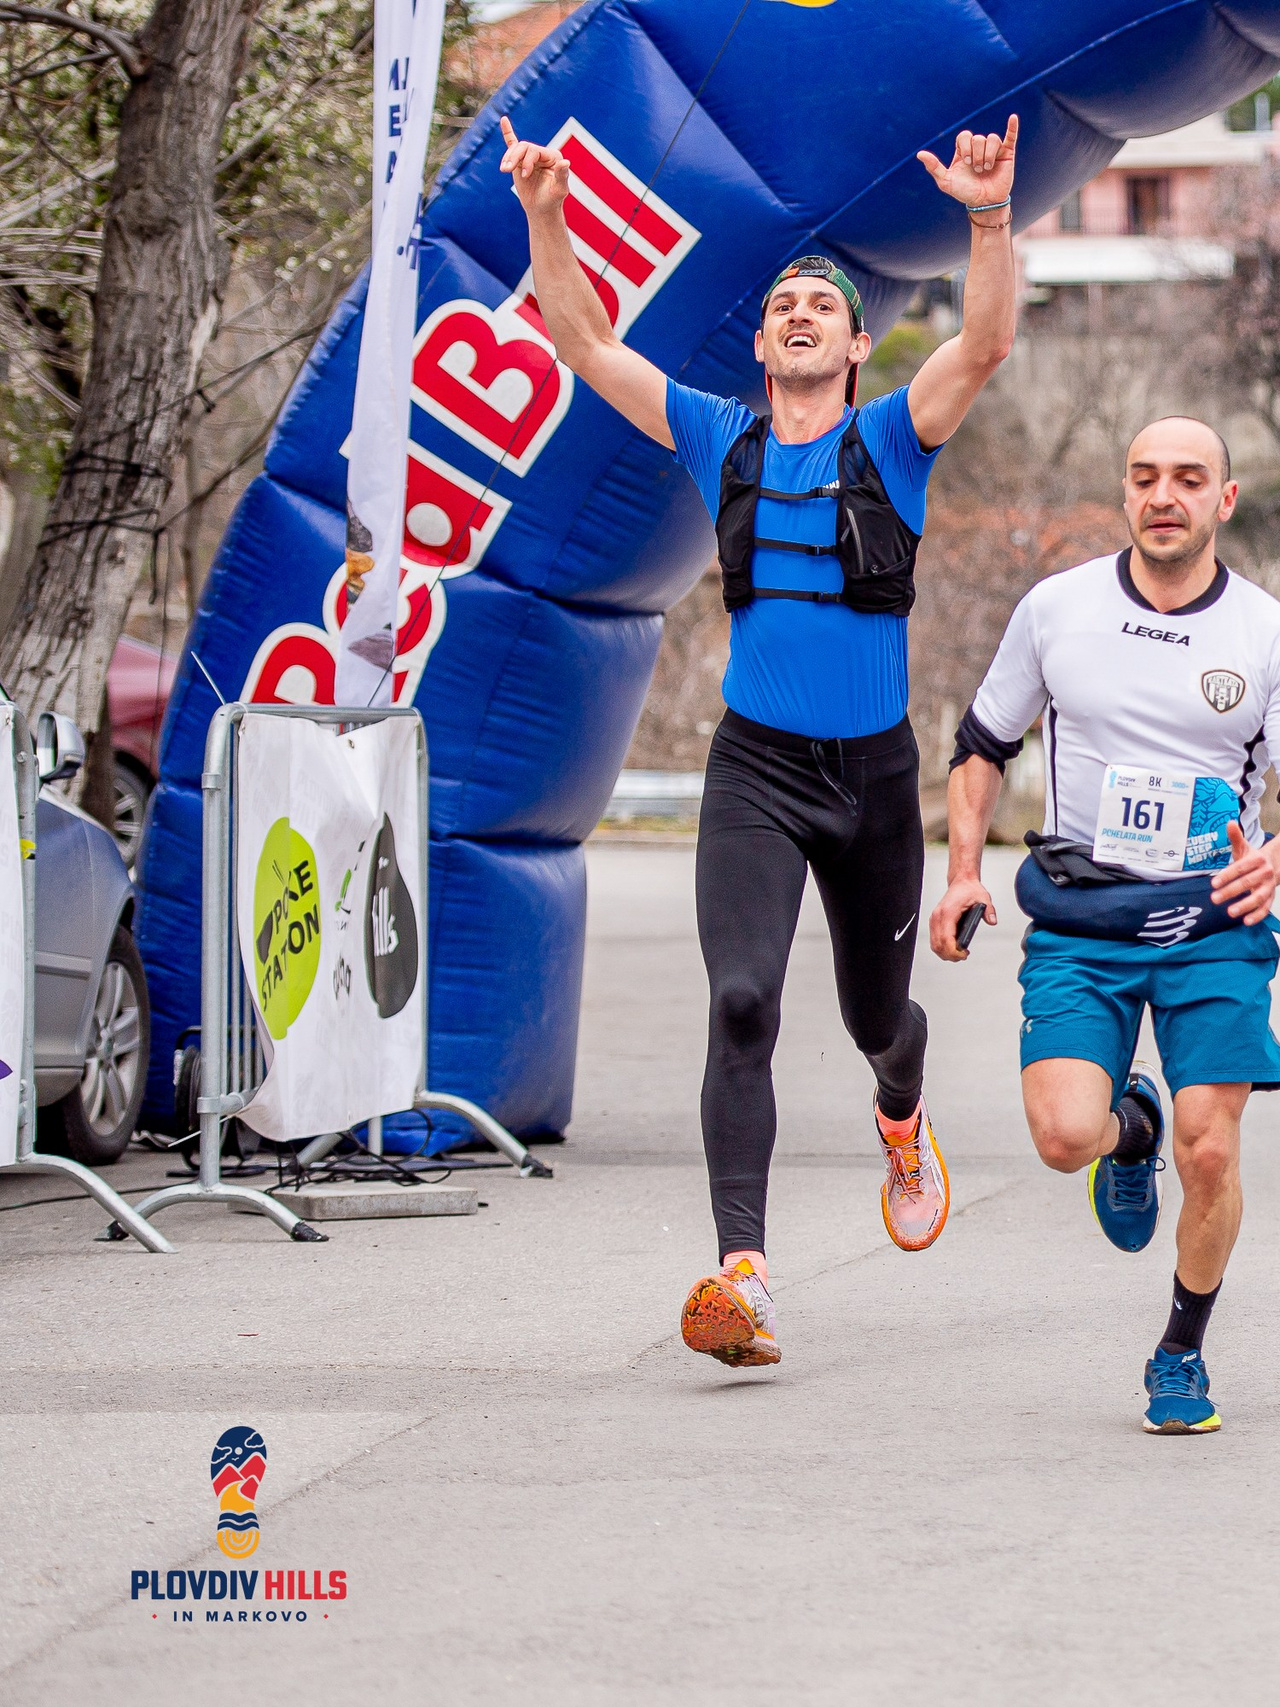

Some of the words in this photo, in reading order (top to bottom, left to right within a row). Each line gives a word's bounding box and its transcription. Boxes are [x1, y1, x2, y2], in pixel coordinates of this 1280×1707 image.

[412, 134, 682, 460] Bll
[1121, 621, 1190, 647] LEGEA
[1121, 796, 1164, 832] 161
[1102, 828, 1137, 842] PCHELATA
[1137, 832, 1153, 843] RUN
